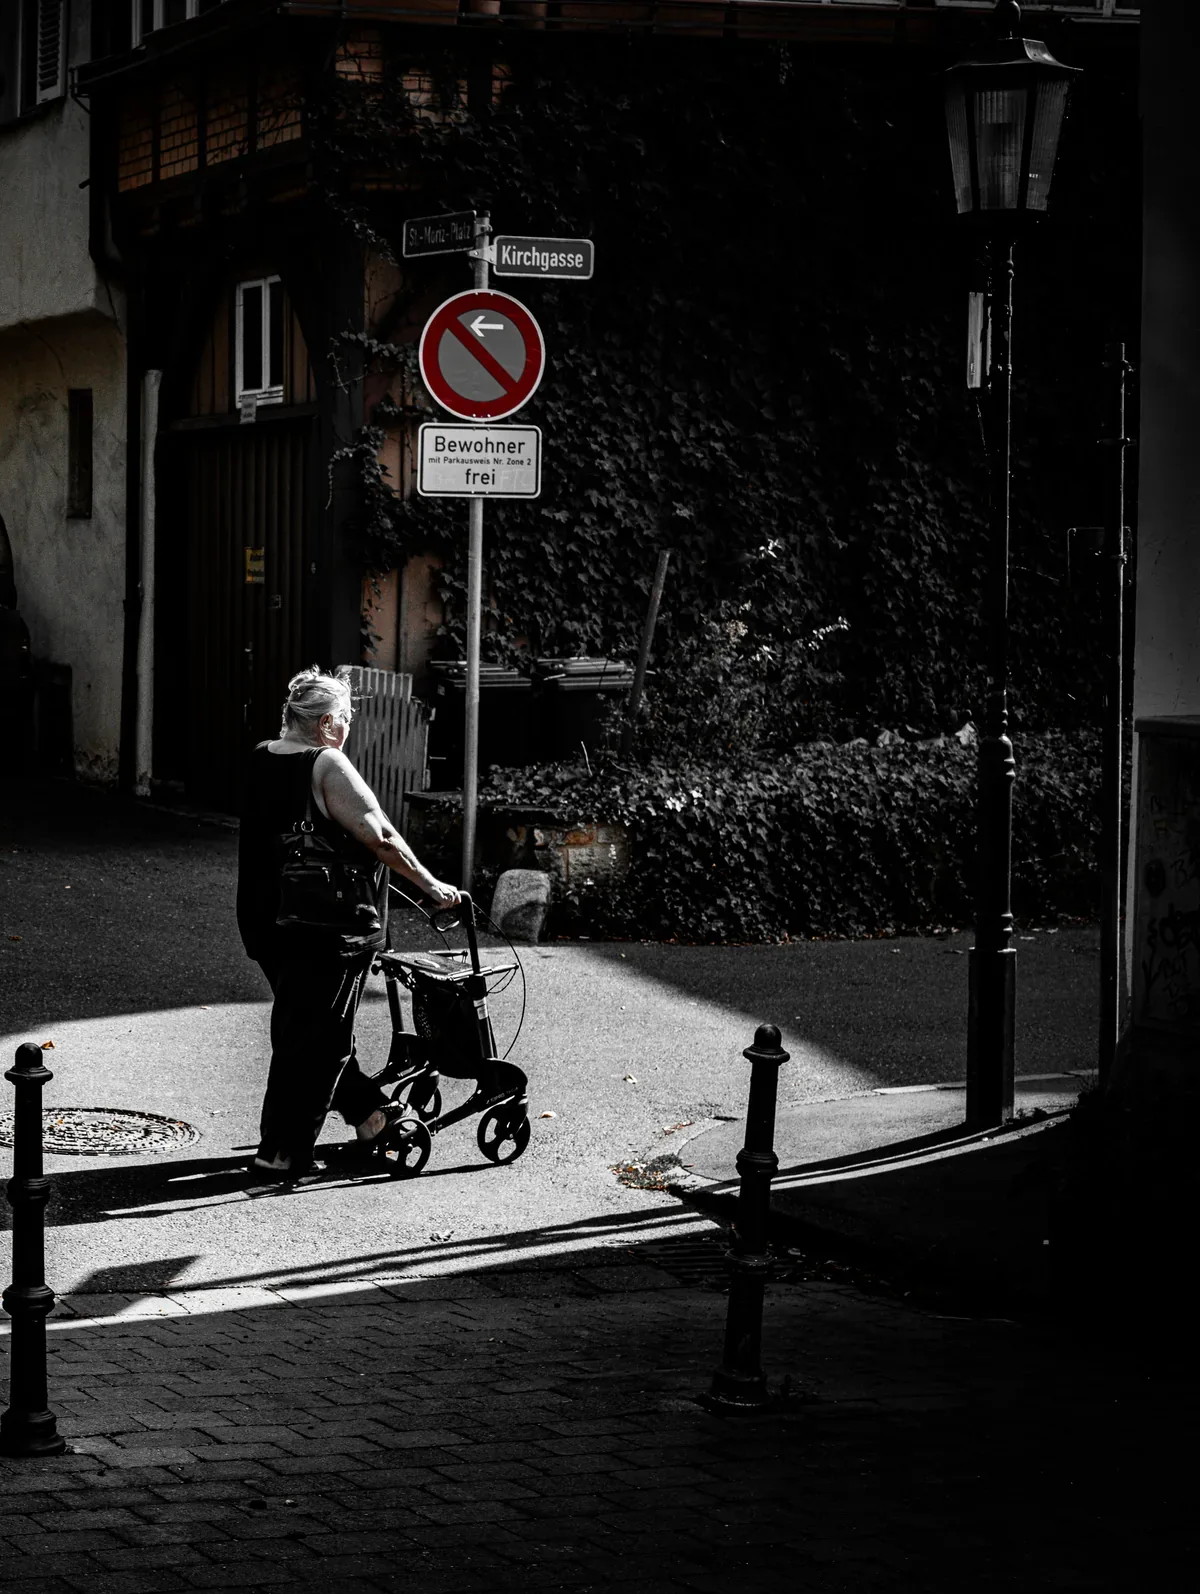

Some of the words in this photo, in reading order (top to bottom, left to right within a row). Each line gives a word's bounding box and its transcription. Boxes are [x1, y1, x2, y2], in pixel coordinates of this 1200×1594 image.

[502, 245, 583, 271] Kirchgasse
[435, 436, 525, 454] Bewohner
[443, 456, 491, 465] Parkausweis
[493, 457, 504, 465] Nr.
[465, 468, 495, 485] frei
